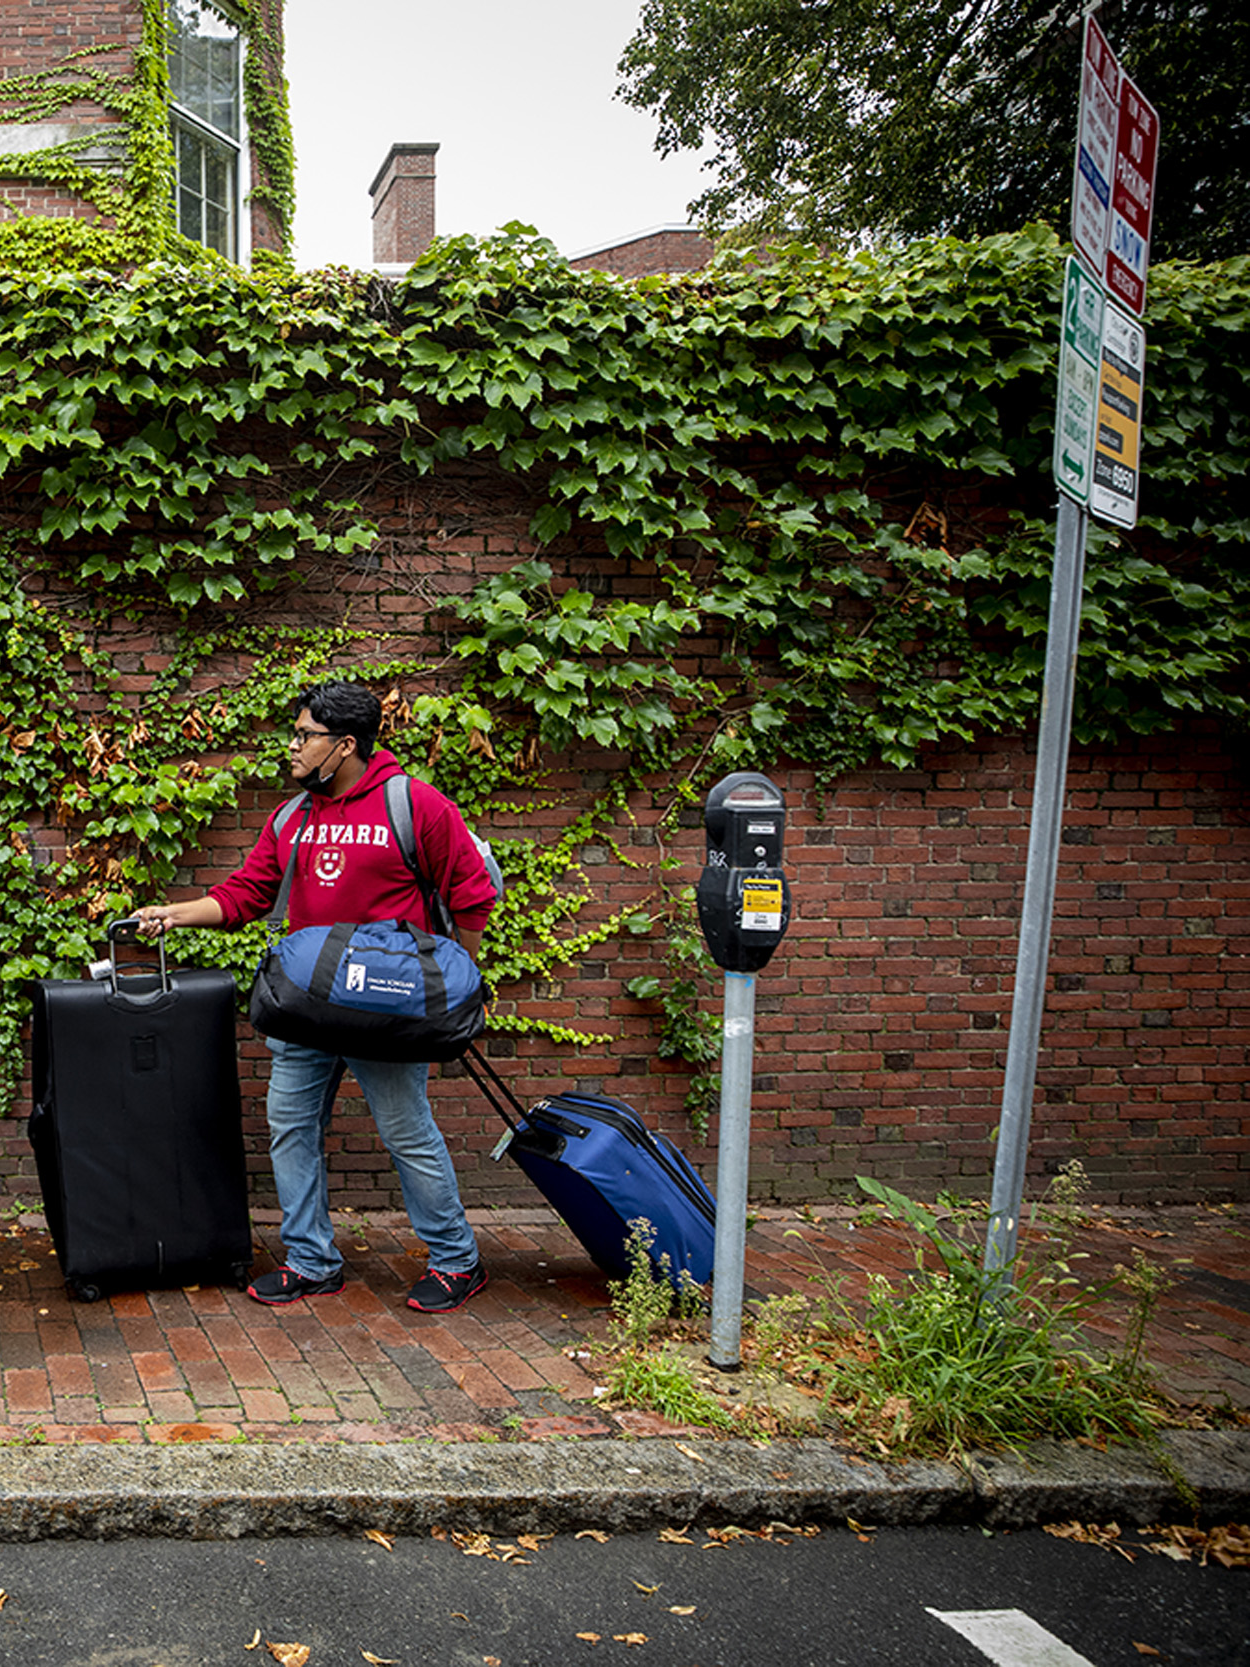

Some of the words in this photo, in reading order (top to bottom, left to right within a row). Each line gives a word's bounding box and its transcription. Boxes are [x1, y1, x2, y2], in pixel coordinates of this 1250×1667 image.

[1128, 93, 1138, 119] TOW
[1139, 107, 1151, 135] ZONE
[1130, 128, 1143, 164] NO
[1117, 152, 1150, 210] PARKING
[1115, 219, 1142, 270] SNOW
[1112, 263, 1139, 302] EMERGENCY
[1067, 277, 1076, 332] 2
[1076, 317, 1099, 361] PARKING
[1096, 459, 1111, 479] Zone
[1112, 465, 1133, 493] 6950
